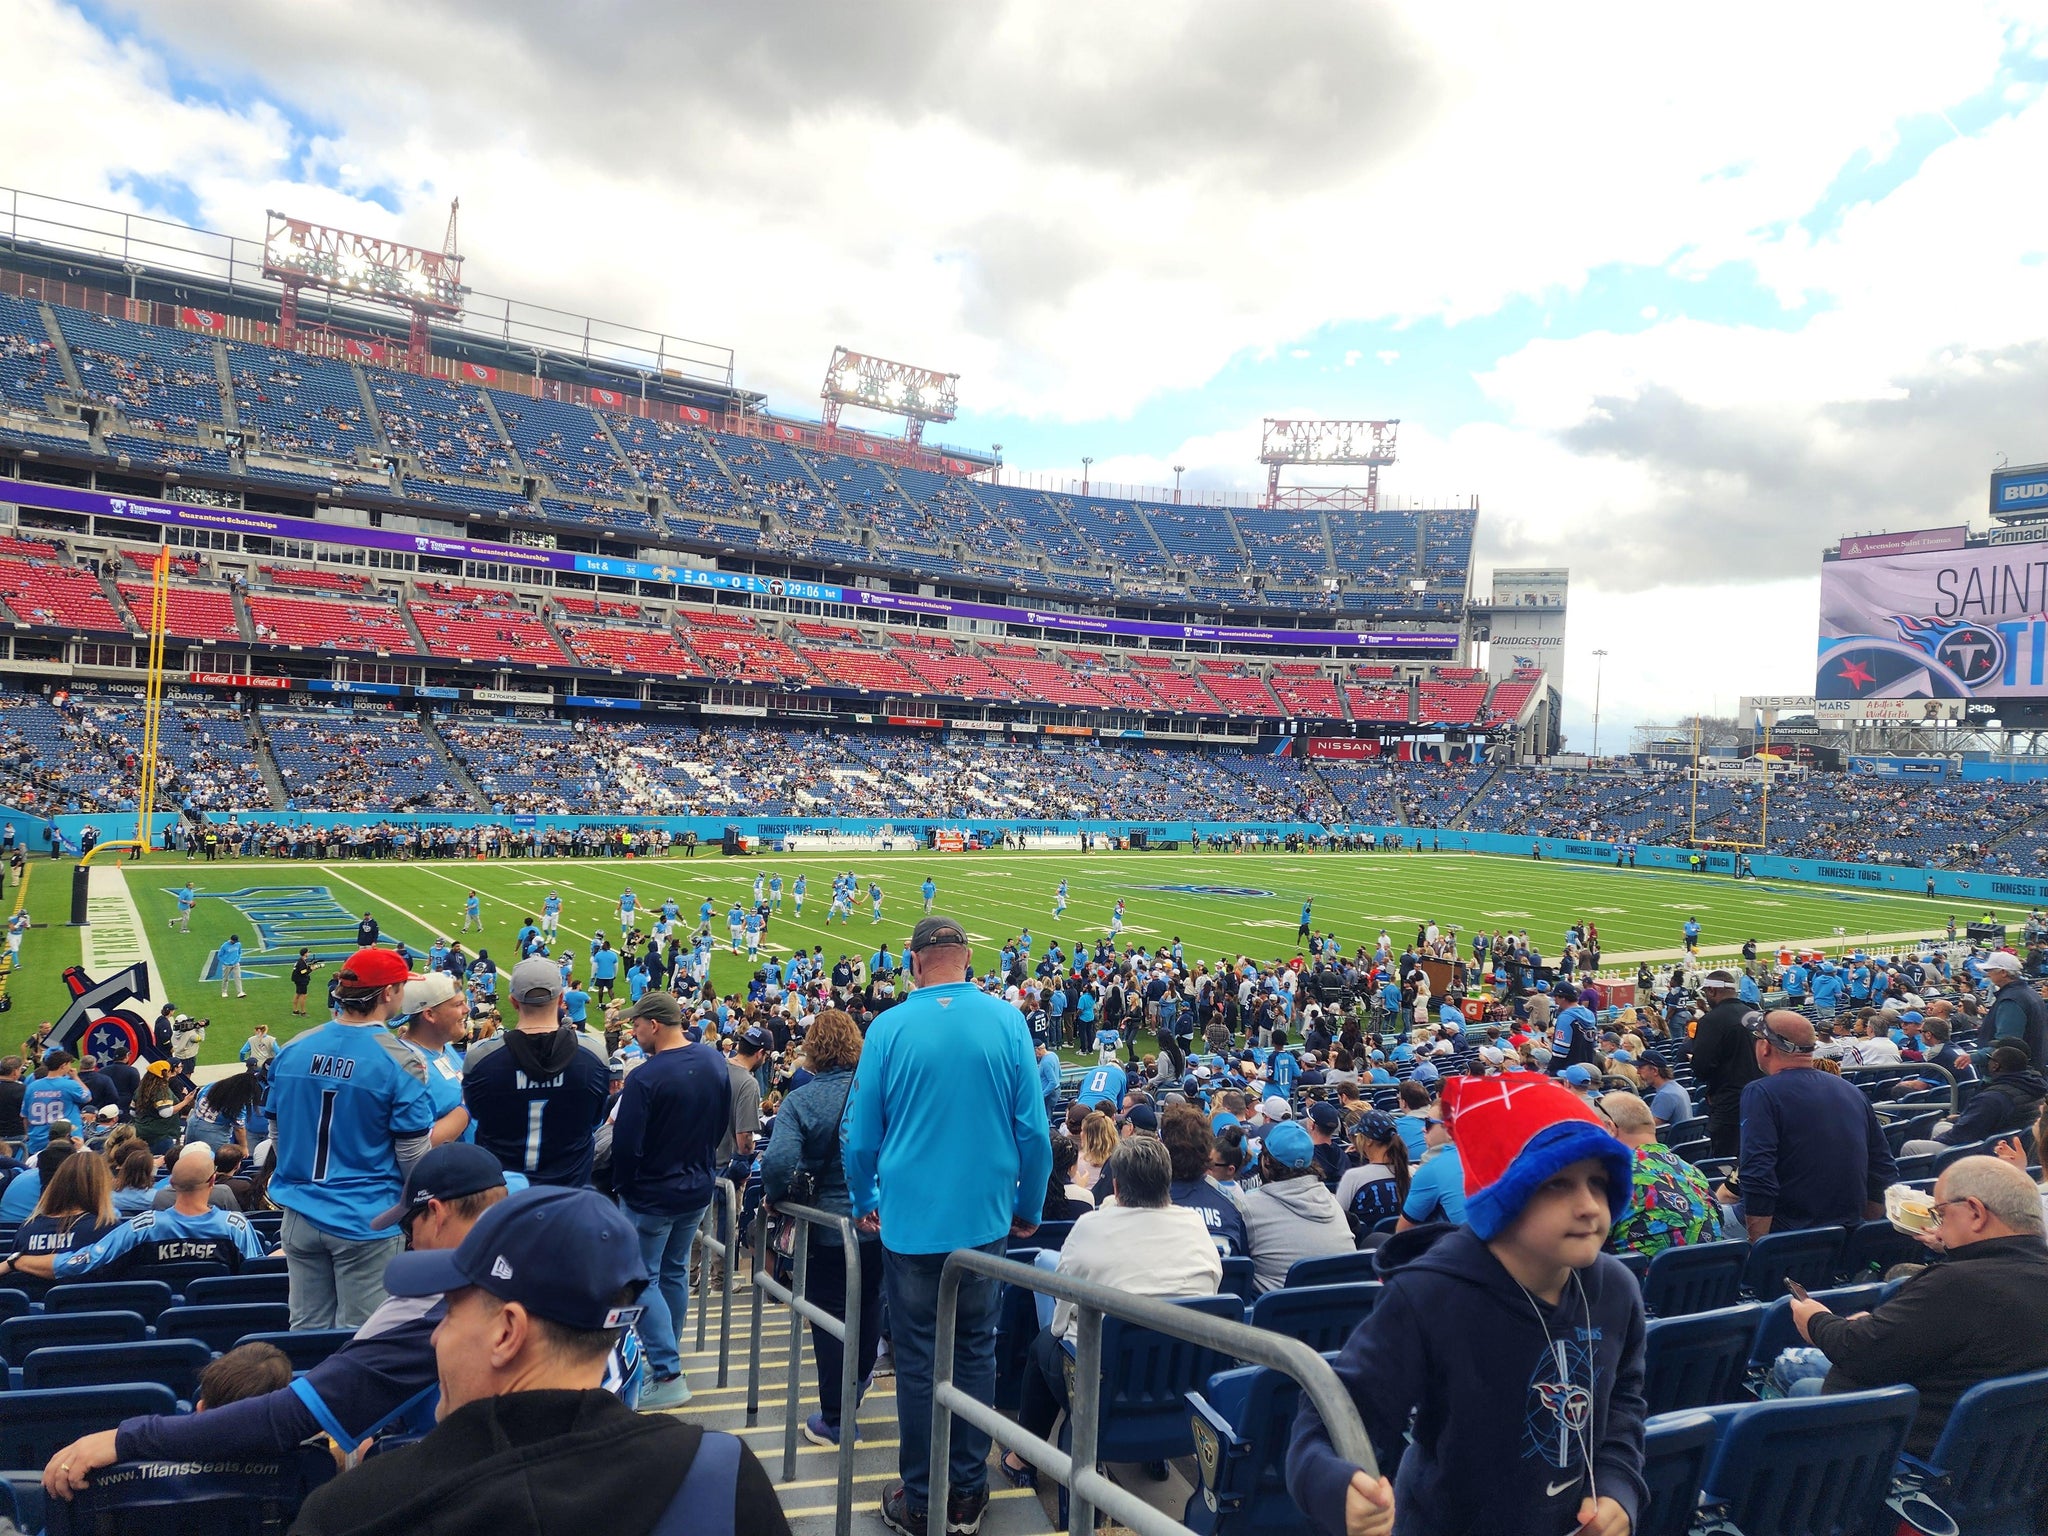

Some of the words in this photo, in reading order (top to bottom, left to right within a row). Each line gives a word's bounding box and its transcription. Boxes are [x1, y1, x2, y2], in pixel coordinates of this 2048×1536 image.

[129, 503, 171, 515] Tennessee
[179, 511, 226, 523] Guaranteed
[226, 517, 277, 530] Scholarships
[1991, 525, 2048, 543] Pinnacl
[430, 540, 465, 551] Tennessee
[1863, 542, 1900, 551] Ascension
[1901, 539, 1920, 548] Saint
[1921, 537, 1952, 546] Thomas
[471, 546, 509, 557] Guaranteed
[509, 551, 550, 562] Scholarships
[587, 560, 600, 570] 1st
[602, 562, 609, 571] &
[626, 566, 636, 574] 35
[698, 572, 708, 583] 0
[732, 577, 741, 588] 0
[789, 583, 819, 597] 29:06
[825, 589, 835, 598] 1st
[898, 598, 924, 607] Guaranteed
[924, 602, 952, 611] Scholarships
[1492, 636, 1563, 646] BRIDGESTONE
[71, 682, 98, 691] RING
[108, 684, 146, 693] HONOR
[167, 692, 203, 701] ADAMS
[1752, 697, 1816, 706] NISSAN
[1819, 701, 1851, 711] MARS
[1968, 704, 1996, 714] 29:06
[1865, 710, 1887, 718] World
[1774, 727, 1819, 735] PATHFINDER
[1318, 741, 1372, 751] NISSAN
[757, 824, 790, 834] TENNESSEE
[1565, 844, 1592, 856] TENNESSEE
[1594, 847, 1612, 857] TOUGH
[1710, 857, 1730, 868] TOUGH
[1818, 866, 1855, 879] TENNESSEE
[1858, 870, 1882, 881] TOUGH
[1991, 882, 2036, 896] TENNESSEE
[91, 928, 140, 956] TAKES
[1789, 973, 1796, 984] 8
[1914, 971, 1923, 982] 17
[1465, 1003, 1478, 1015] G
[1034, 1018, 1047, 1032] 69
[309, 1053, 356, 1080] WARD
[1090, 1071, 1108, 1092] 8
[1279, 1068, 1290, 1086] 11
[33, 1090, 62, 1098] SIMMONS
[30, 1101, 65, 1125] 98
[312, 1089, 339, 1182] 1
[525, 1099, 549, 1172] 1
[28, 1232, 75, 1250] HENRY
[96, 1461, 280, 1487] www.TitansSeats.com
